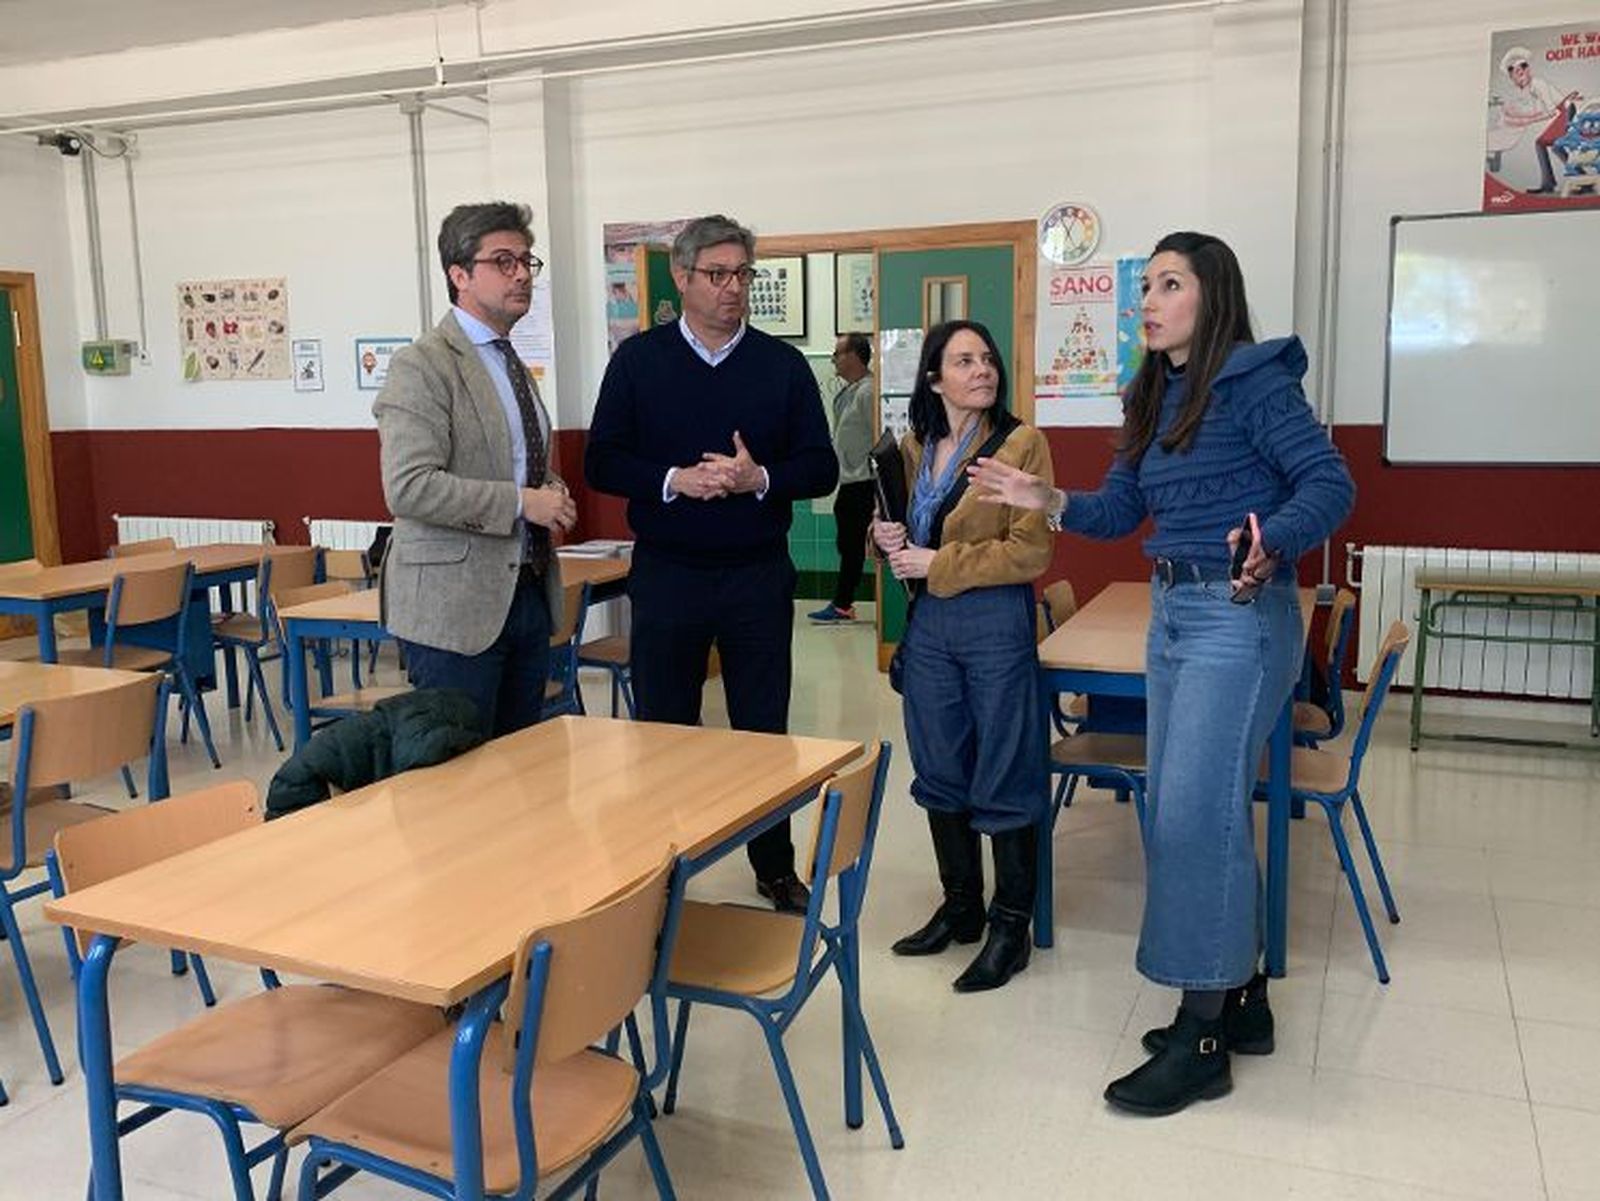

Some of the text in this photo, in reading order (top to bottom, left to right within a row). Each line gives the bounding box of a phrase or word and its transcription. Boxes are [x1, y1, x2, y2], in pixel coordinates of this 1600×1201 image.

[1561, 33, 1581, 46] WE
[1546, 48, 1573, 61] OUR
[1050, 275, 1113, 296] SANO
